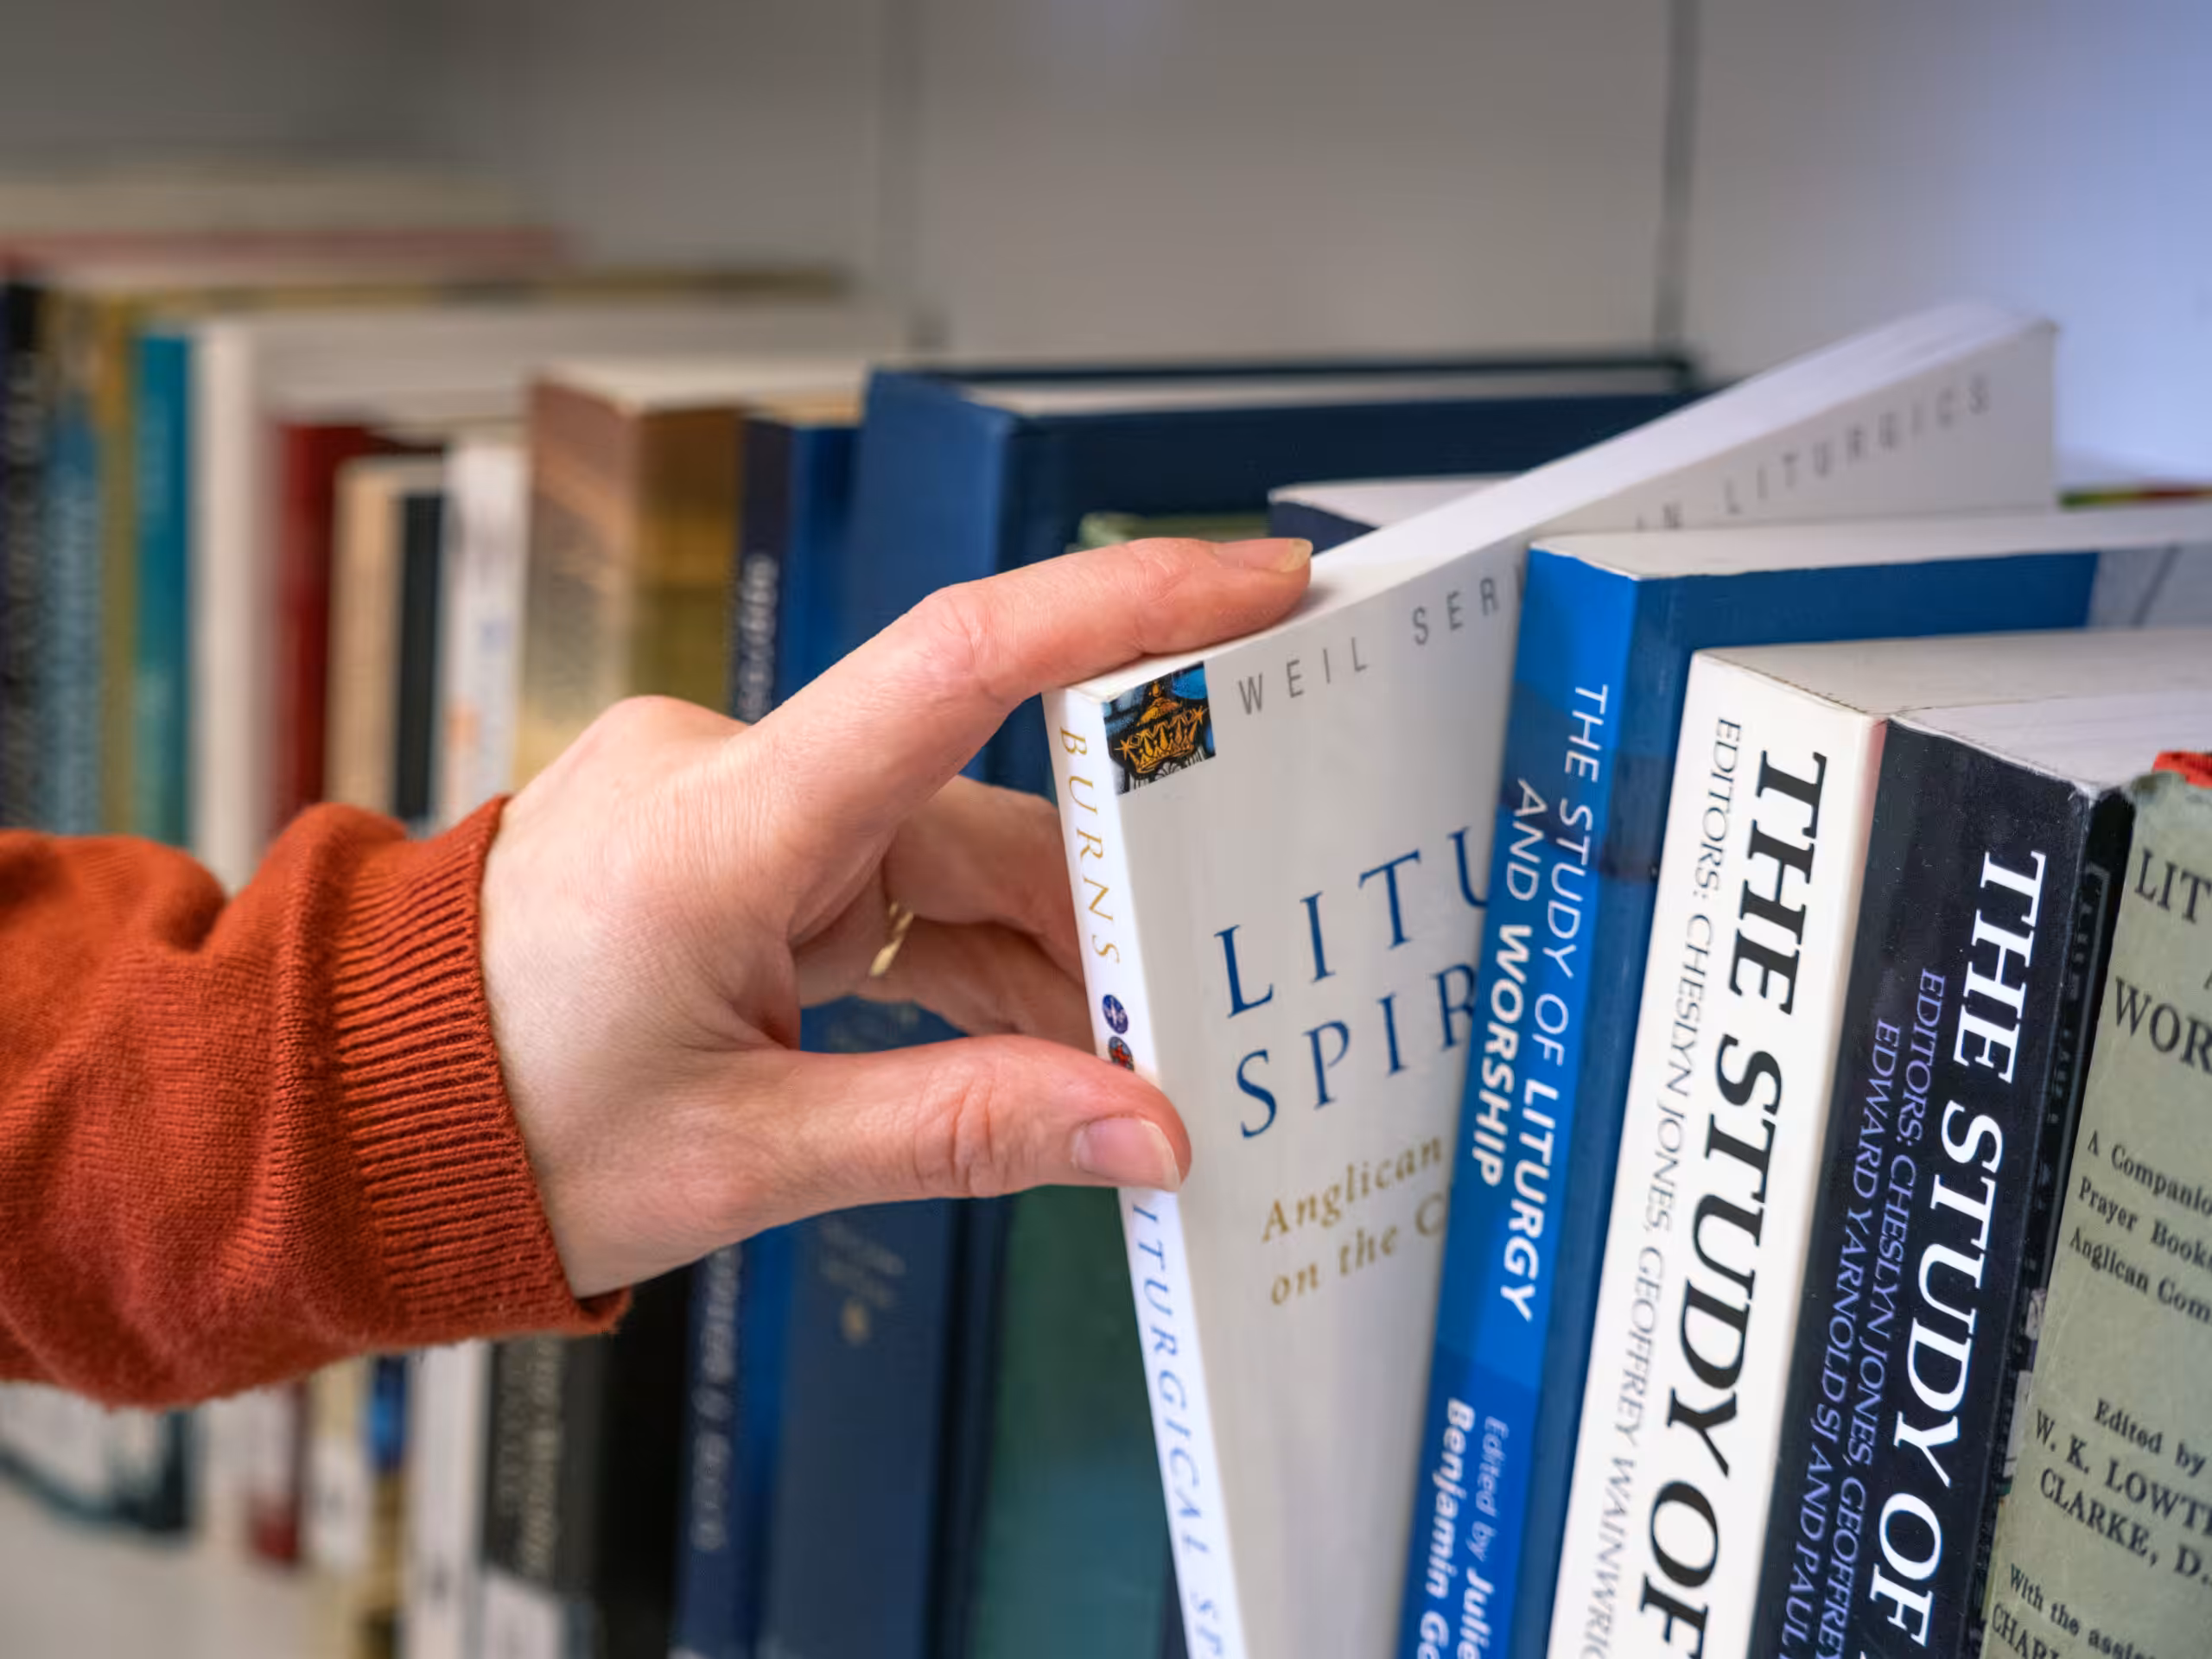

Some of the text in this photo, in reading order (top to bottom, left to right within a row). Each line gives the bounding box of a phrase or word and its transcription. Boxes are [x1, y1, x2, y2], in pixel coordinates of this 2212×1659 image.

[1238, 636, 1369, 715] WEIL
[1723, 373, 1990, 515] LITURGICS
[1059, 727, 1121, 964] BURNS
[1694, 717, 1743, 899] EDITORS:
[2134, 844, 2212, 925] LIT
[1236, 962, 1475, 1139] SPIR
[1472, 779, 1548, 1187] AND WORSHIP
[1501, 684, 1609, 1322] THE STUDY OF LITURGY
[1666, 914, 1713, 1097] CHESLYN
[1897, 968, 1946, 1147] EDITORS:
[1853, 1018, 1901, 1198] EDWARD
[2087, 1129, 2100, 1157] A
[1261, 1135, 1443, 1243] Anglican
[1639, 750, 1827, 1659] THE STUDY OF
[1867, 1153, 1917, 1340] CHESLYN
[1869, 850, 2047, 1647] THE STUDY OF
[2079, 1175, 2138, 1232] Prayer
[1269, 1262, 1320, 1306] on
[1338, 1228, 1400, 1276] the
[1822, 1209, 1875, 1402] YARNOLD
[2069, 1226, 2211, 1324] Anglican Com
[1133, 1205, 1211, 1554] ITURGICAL
[1614, 1245, 1664, 1446] GEOFFREY
[1843, 1337, 1889, 1466] JONES,
[1426, 1398, 1476, 1599] Benjamin
[1476, 1415, 1509, 1518] Edited
[1800, 1443, 1833, 1541] AND
[1811, 1403, 1841, 1444] SJ
[2037, 1408, 2056, 1452] W.
[2067, 1434, 2090, 1474] K.
[2094, 1397, 2206, 1478] Edited by
[1465, 1521, 1497, 1562] by
[1782, 1541, 1820, 1646] PAUL
[2040, 1468, 2158, 1567] CLARKE,
[2011, 1562, 2044, 1612] With
[2050, 1602, 2080, 1637] the
